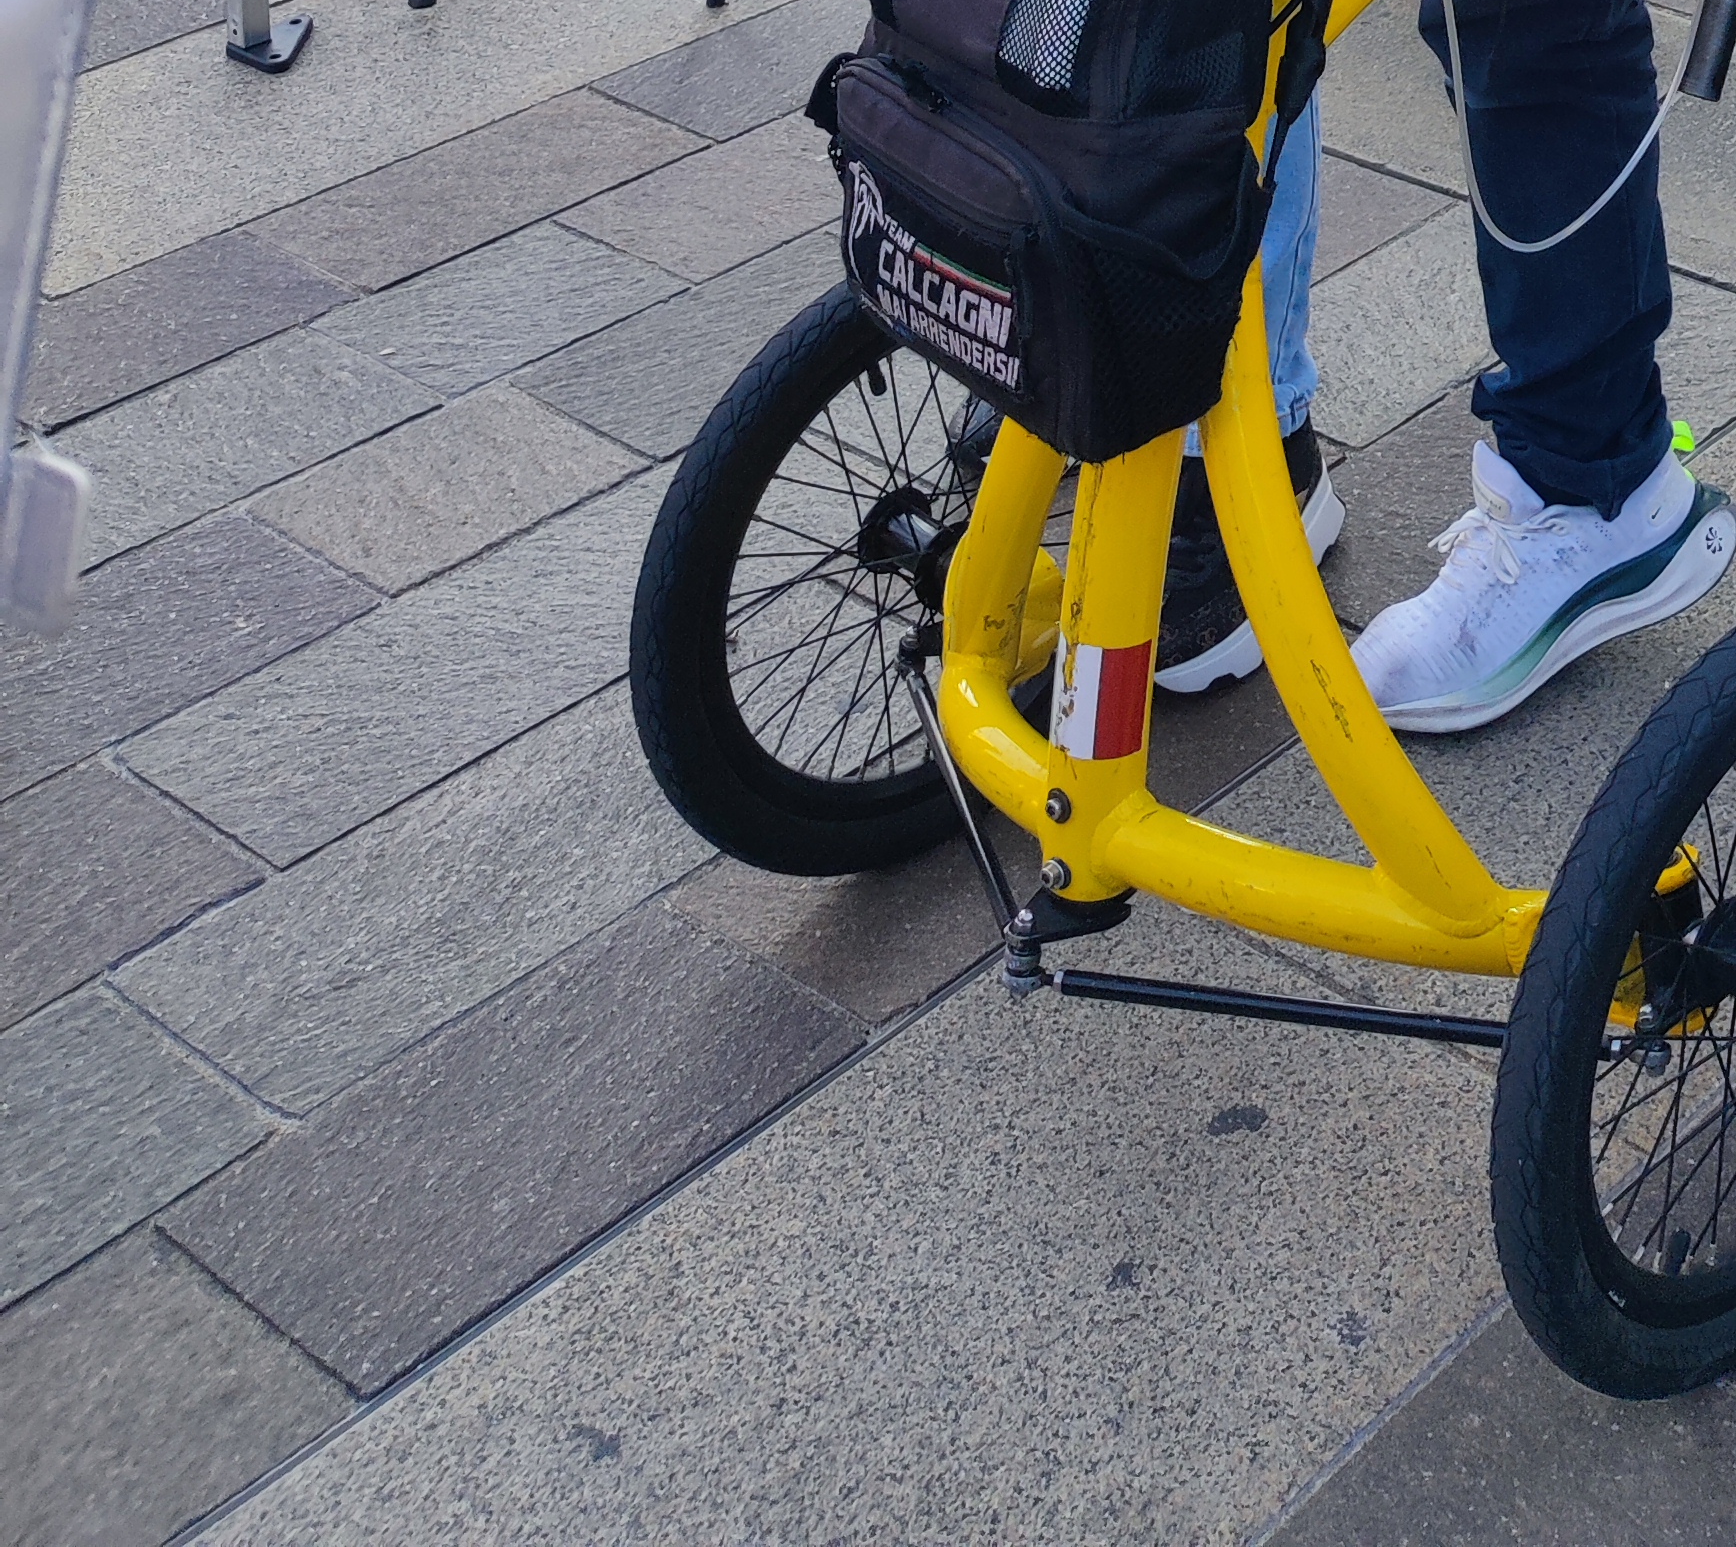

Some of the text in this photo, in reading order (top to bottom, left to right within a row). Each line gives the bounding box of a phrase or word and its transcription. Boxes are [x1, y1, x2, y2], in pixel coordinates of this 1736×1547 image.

[882, 213, 916, 253] TEAM
[877, 283, 908, 325] MAI
[878, 239, 1013, 348] CALCAGNI
